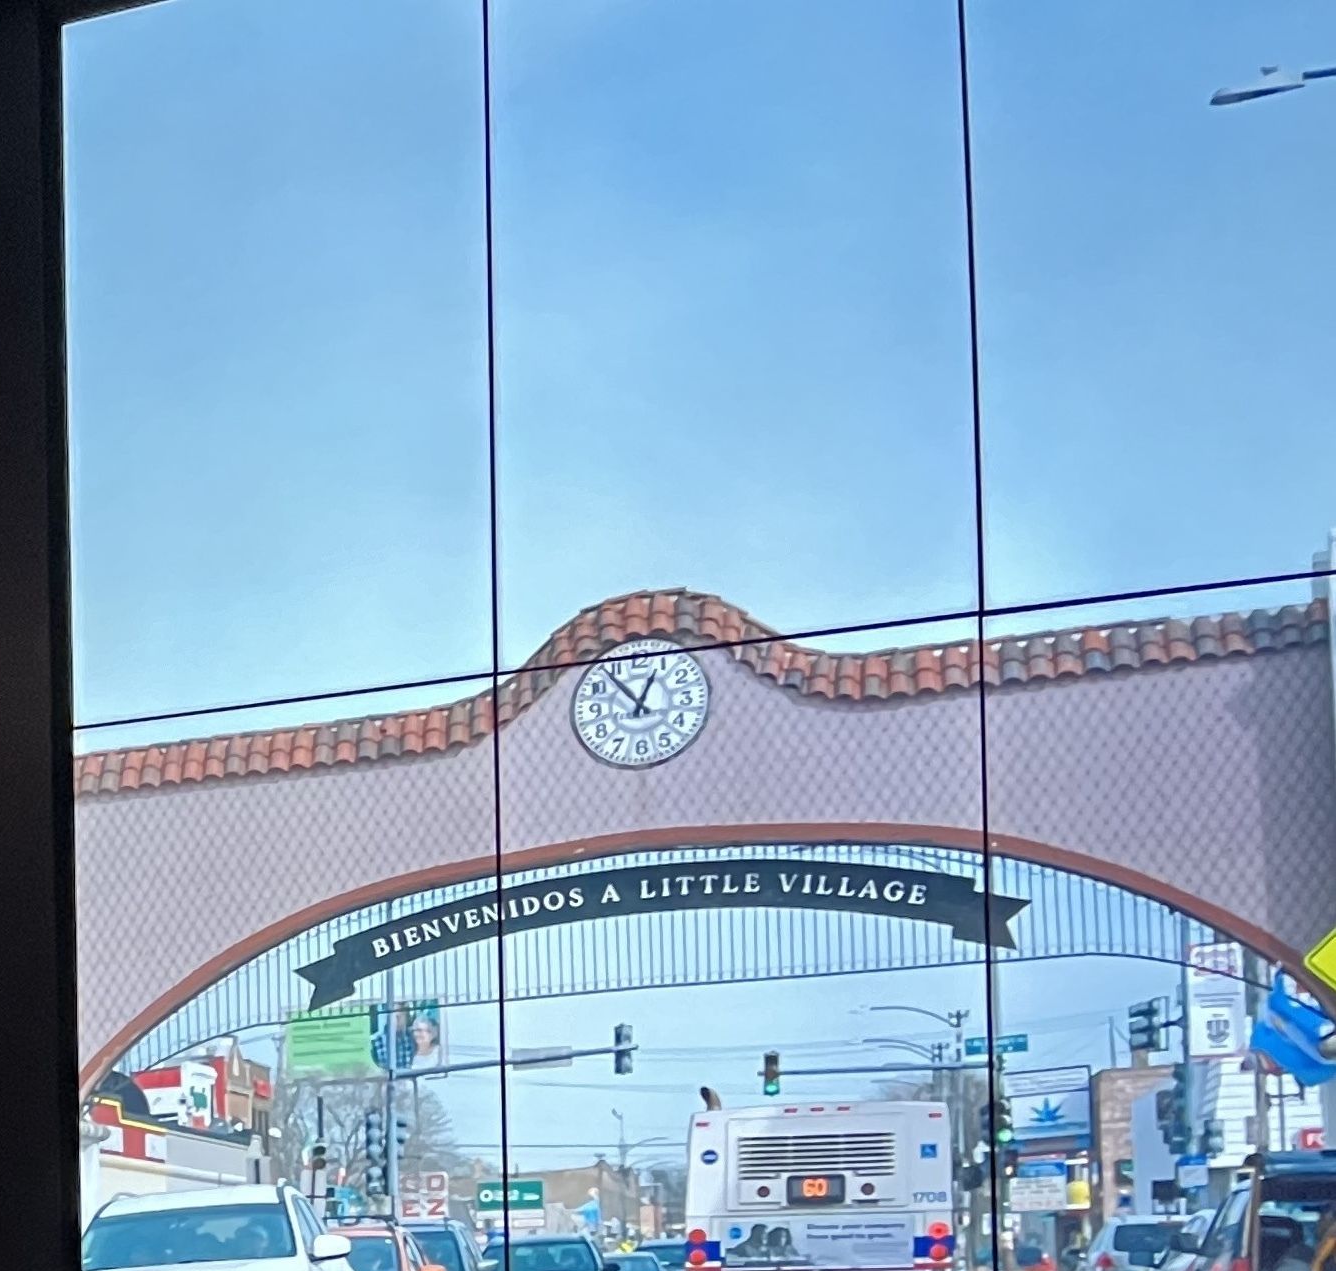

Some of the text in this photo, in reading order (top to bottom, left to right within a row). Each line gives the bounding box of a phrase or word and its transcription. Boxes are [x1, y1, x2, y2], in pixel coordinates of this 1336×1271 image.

[674, 668, 690, 685] 2
[679, 690, 693, 706] 3
[588, 702, 602, 718] 9
[671, 712, 685, 728] 4
[594, 723, 608, 739] 8
[612, 737, 625, 755] 7
[658, 732, 671, 748] 5
[371, 871, 929, 960] BIENVENIDOS A LITTLE VILLAGE
[802, 1178, 829, 1198] 60
